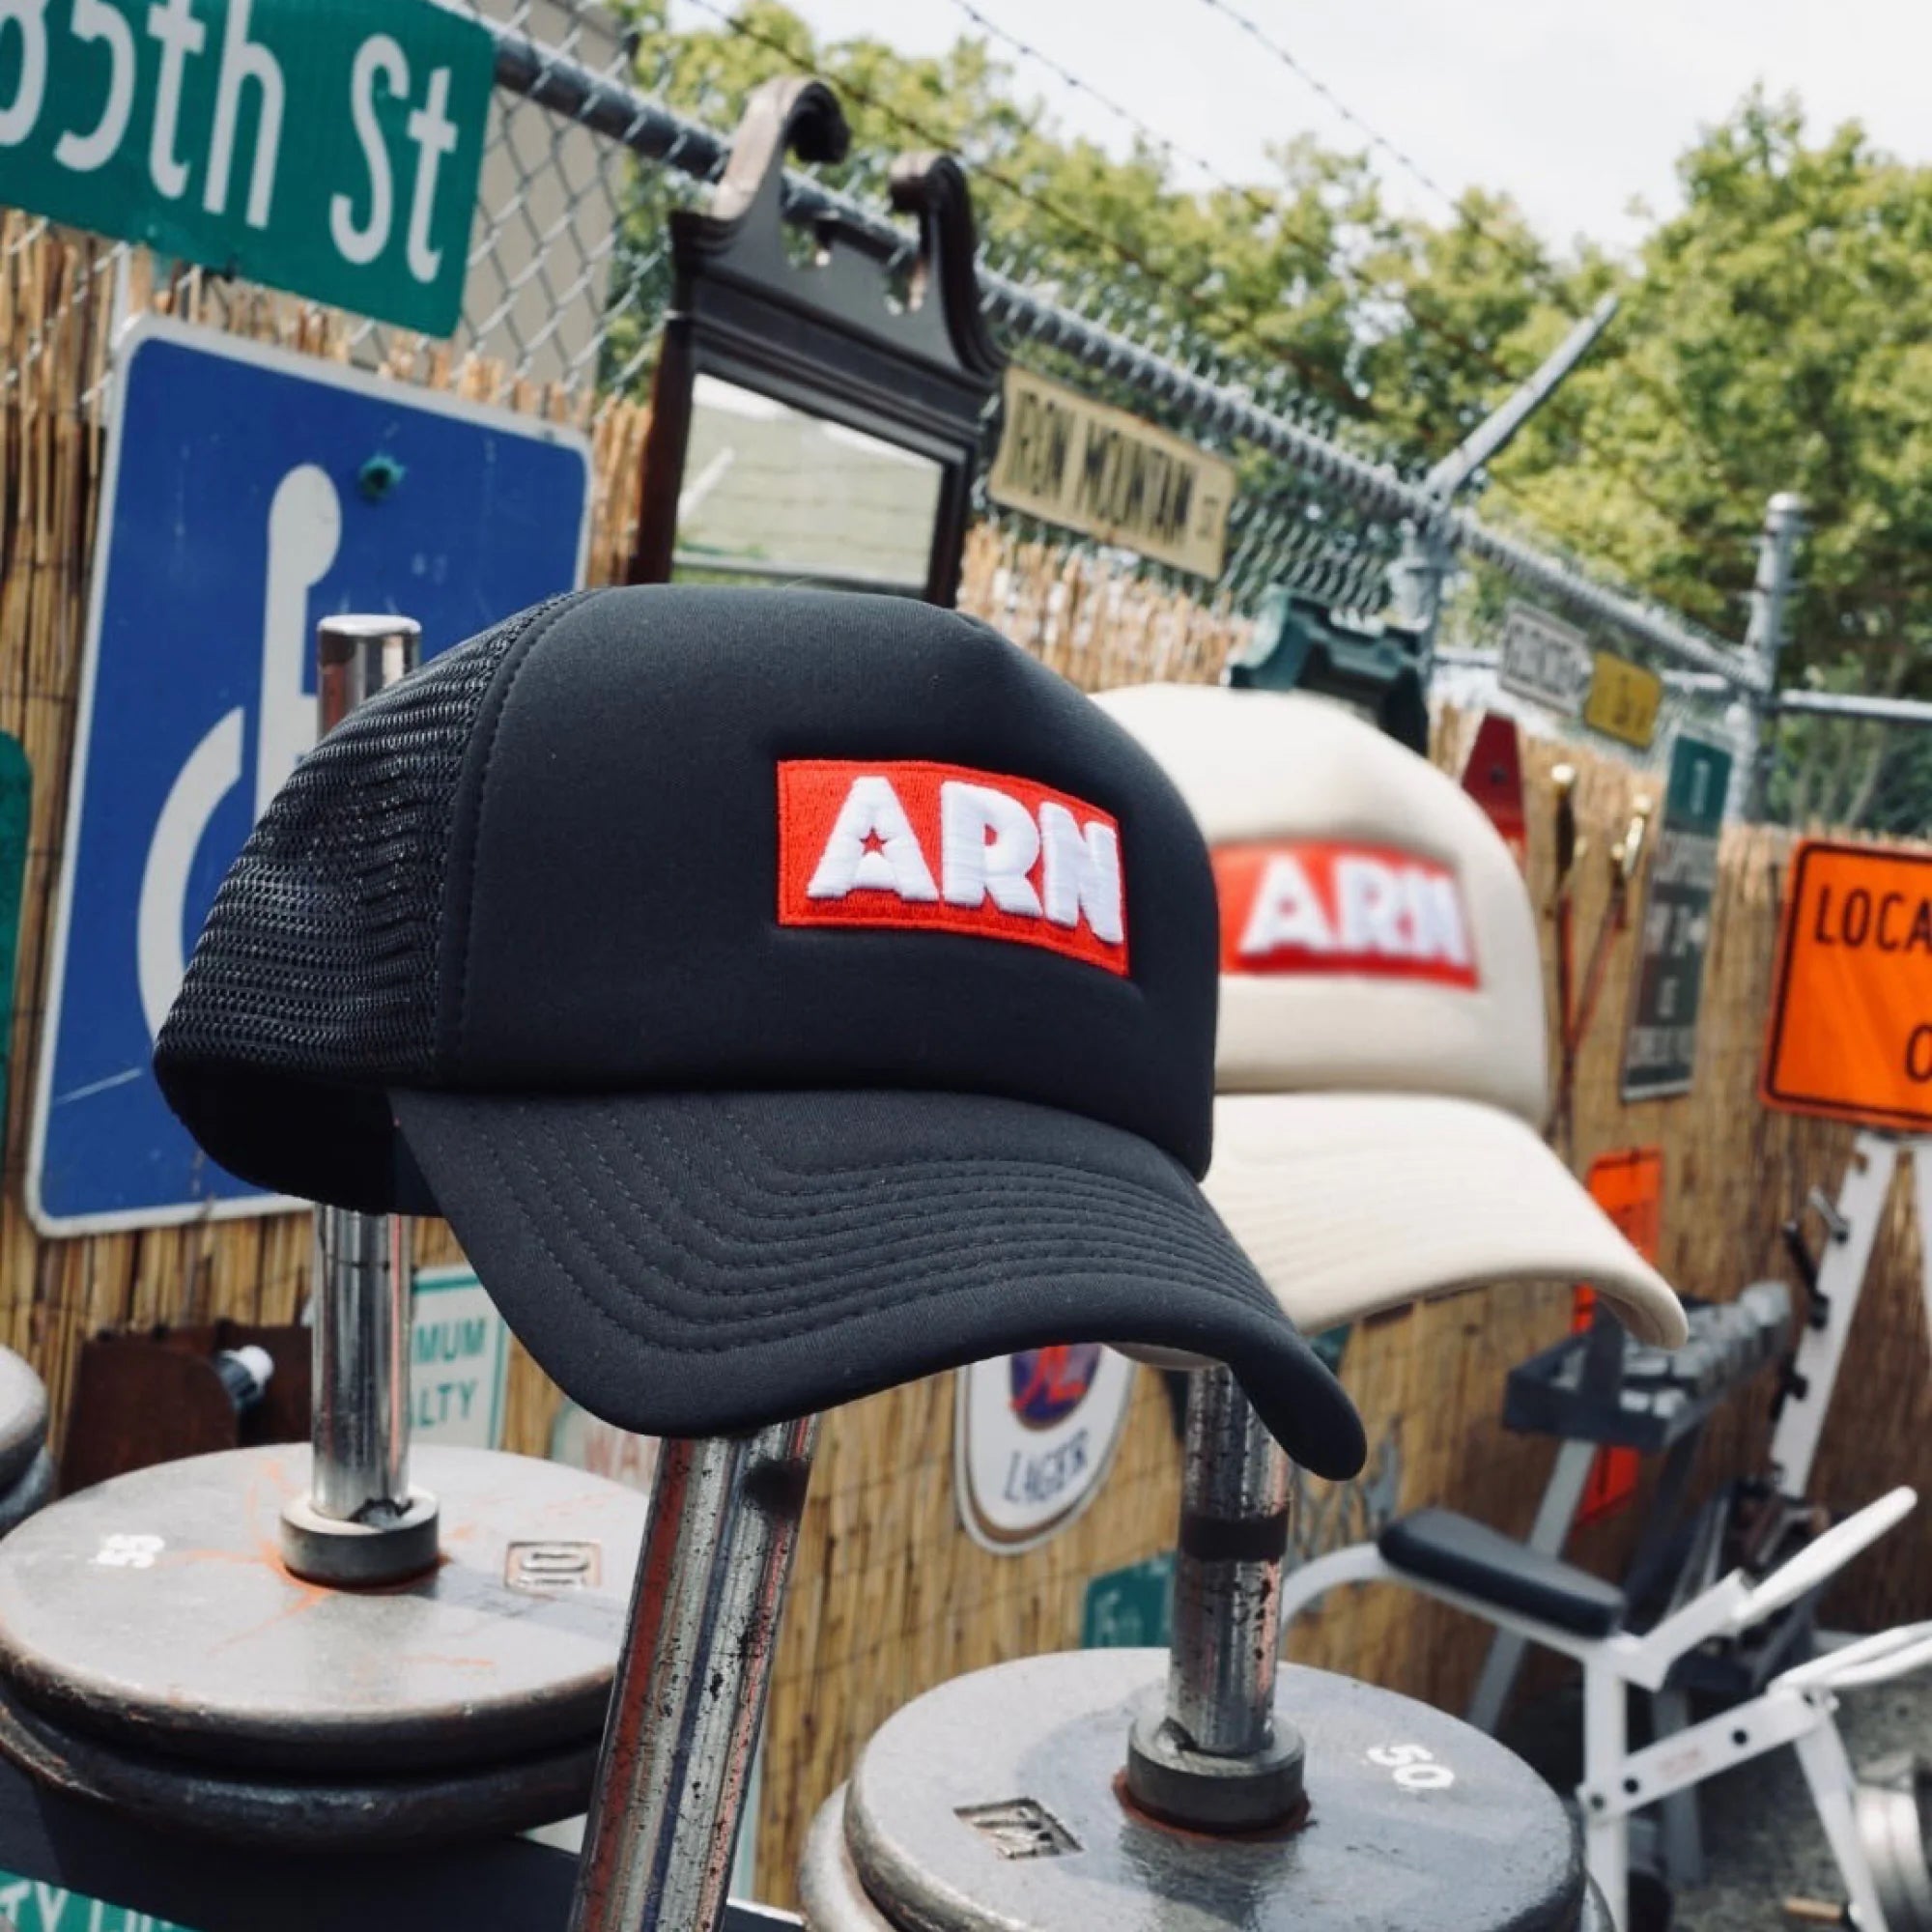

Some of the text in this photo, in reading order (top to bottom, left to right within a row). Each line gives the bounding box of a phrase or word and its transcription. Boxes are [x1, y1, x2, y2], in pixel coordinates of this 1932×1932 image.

[330, 34, 458, 284] St
[806, 775, 1124, 945] ARN
[1238, 850, 1466, 966] ARN
[410, 1378, 479, 1428] LTY
[1366, 1744, 1455, 1789] 50
